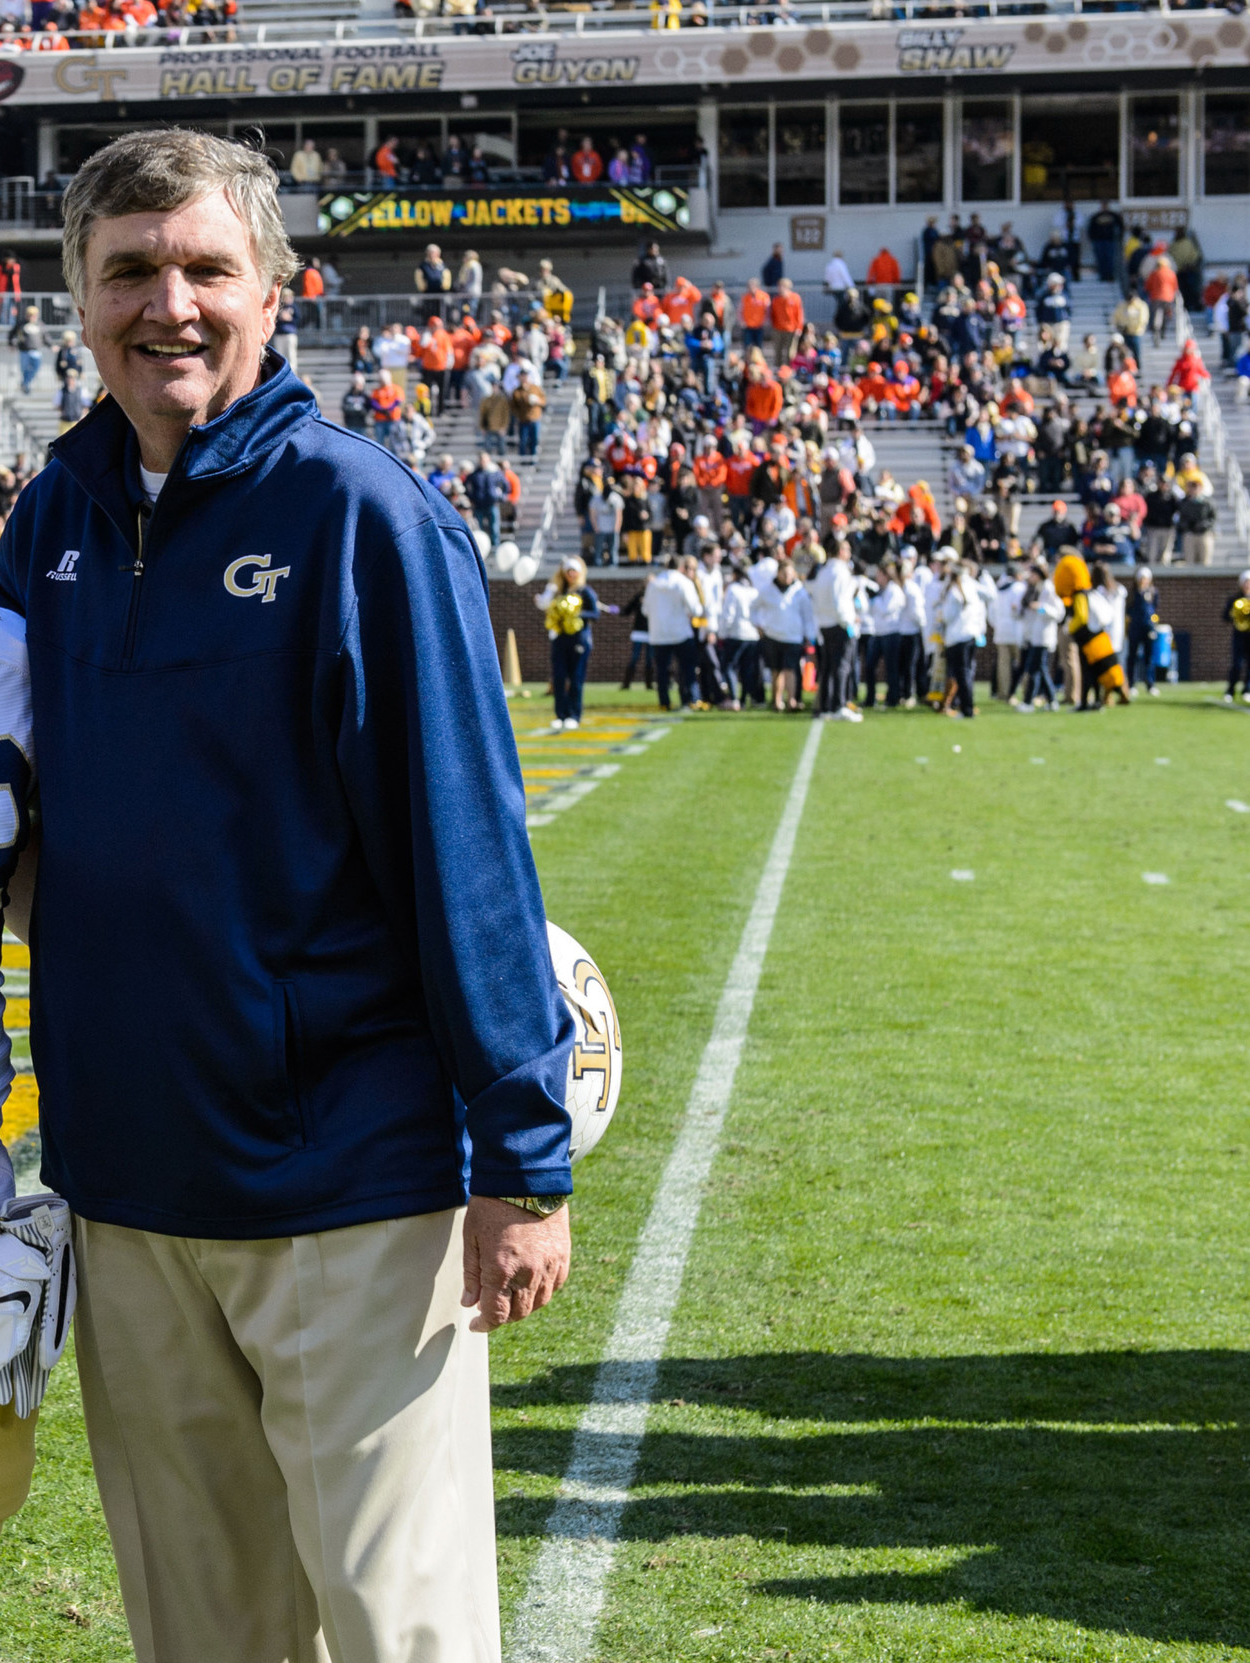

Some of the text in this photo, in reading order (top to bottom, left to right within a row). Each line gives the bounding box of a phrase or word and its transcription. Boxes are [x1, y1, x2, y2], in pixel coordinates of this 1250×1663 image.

[159, 44, 441, 64] PROFESSIONAL FOOTBALL
[898, 43, 1015, 71] SHAW
[160, 61, 444, 97] HALL OF FAME
[513, 56, 640, 84] GUYON
[460, 198, 572, 226] JACKETS
[46, 569, 77, 581] RUSSELL
[224, 553, 291, 603] GT
